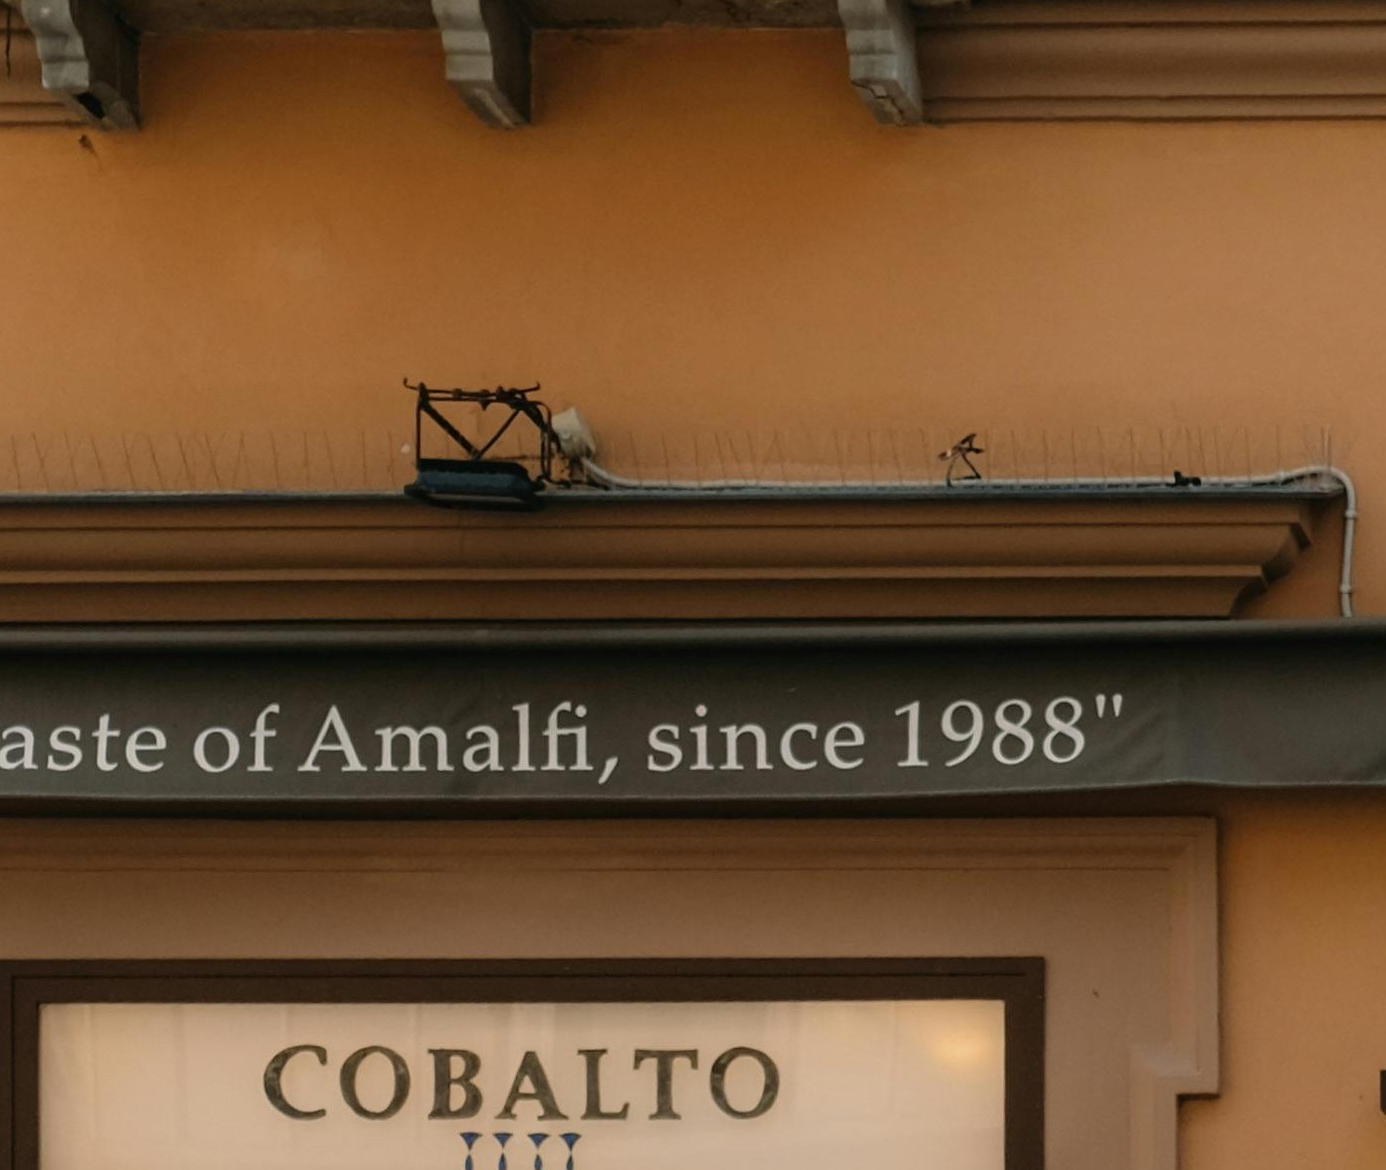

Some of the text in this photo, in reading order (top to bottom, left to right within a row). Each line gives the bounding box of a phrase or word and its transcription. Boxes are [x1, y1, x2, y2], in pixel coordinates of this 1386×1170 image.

[193, 704, 280, 773] of
[298, 701, 618, 784] Amalfi,
[648, 705, 865, 772] since
[895, 694, 1122, 767] 1988"
[263, 1044, 780, 1120] COBALTO
